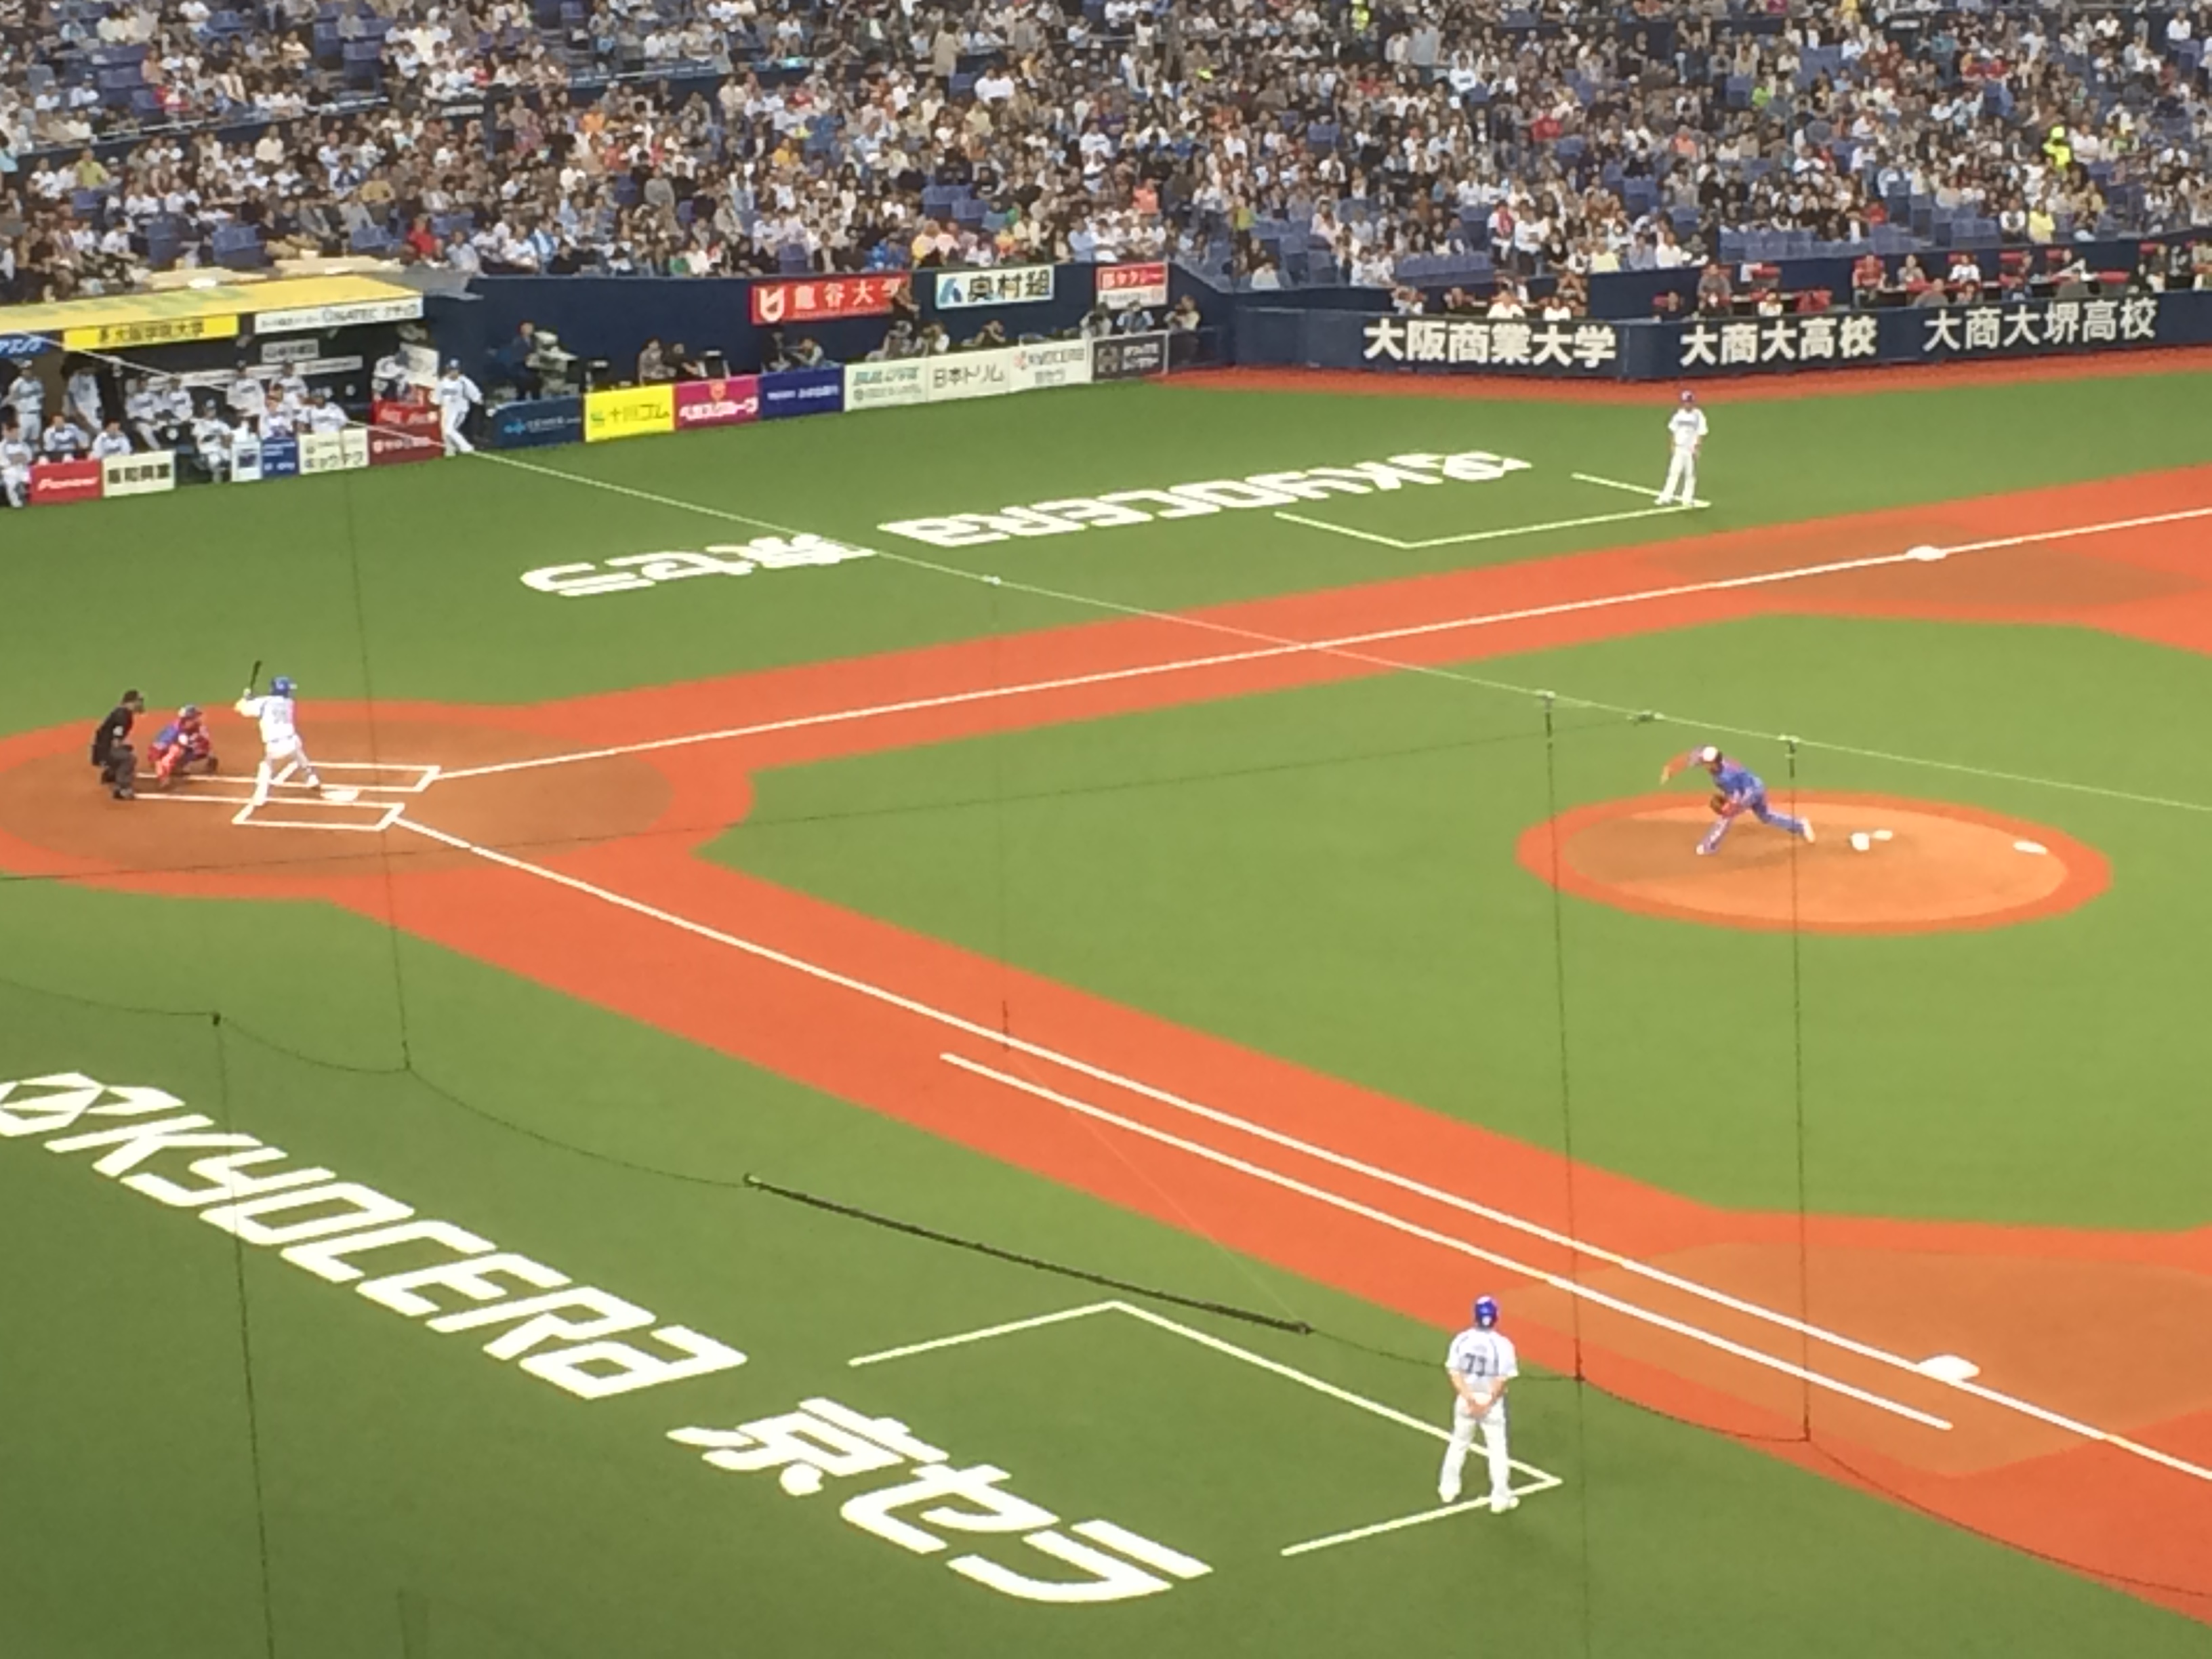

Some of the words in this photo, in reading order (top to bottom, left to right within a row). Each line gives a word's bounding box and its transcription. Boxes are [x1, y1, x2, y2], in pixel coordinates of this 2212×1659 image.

[967, 270, 1050, 302] 奥村組
[1364, 318, 1616, 368] 大阪商業大学
[1680, 315, 1877, 366] 大商大高校
[1923, 297, 2156, 352] 大商大堺高校
[933, 365, 1005, 388] 日本トリム
[877, 461, 1443, 547] KYOCERA
[44, 1113, 747, 1399] KYOCERA
[667, 1397, 1213, 1603] 京セラ
